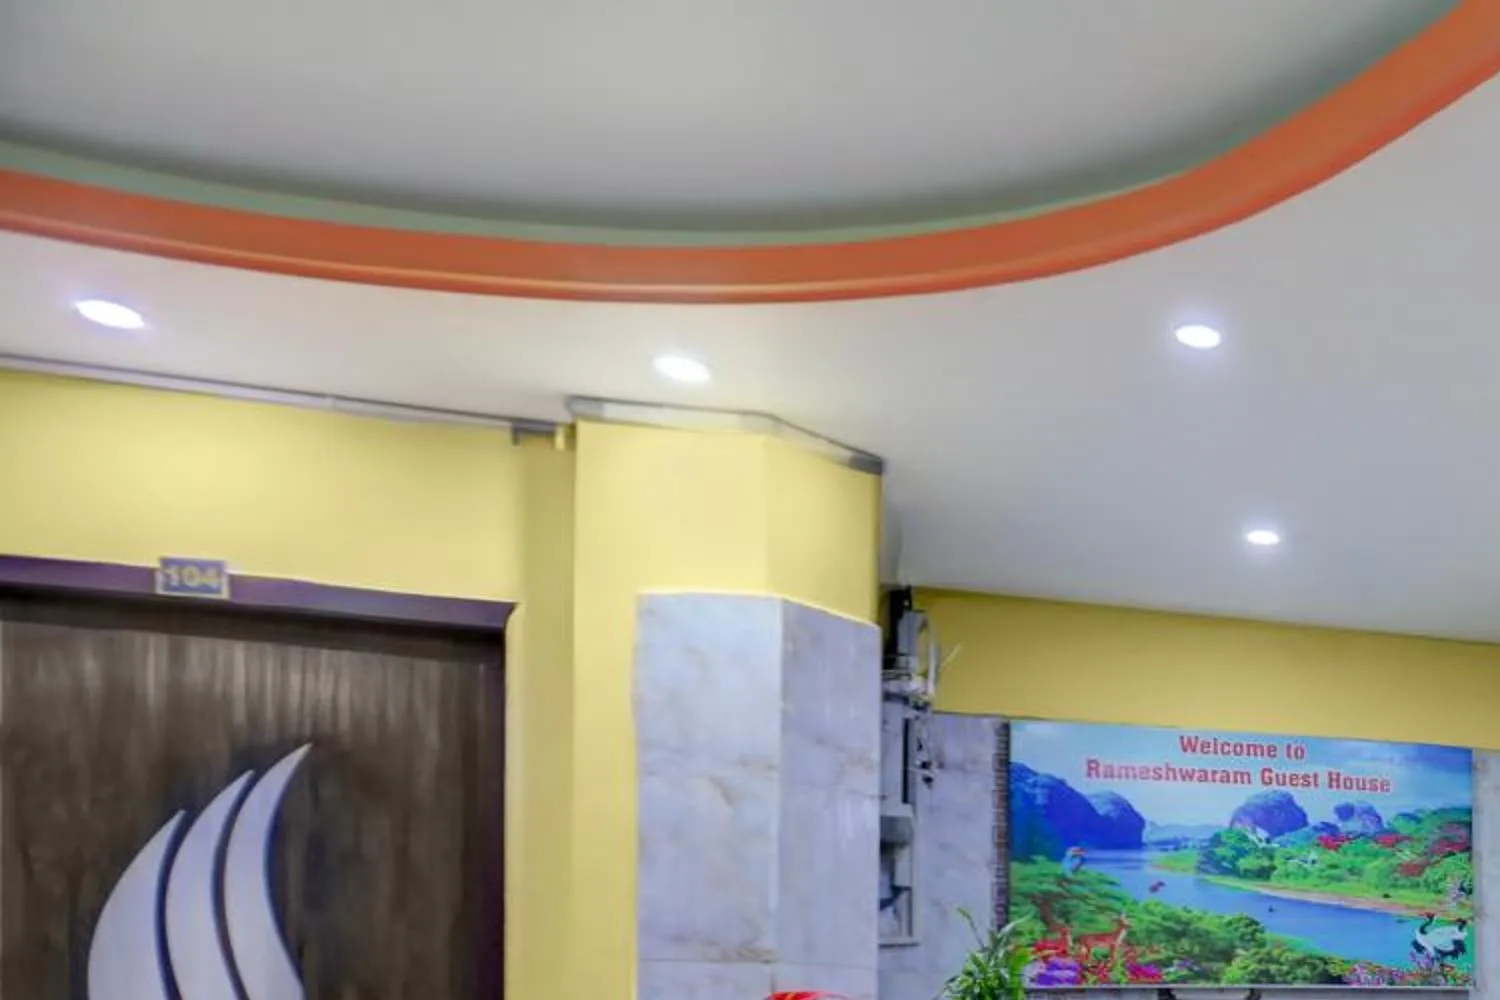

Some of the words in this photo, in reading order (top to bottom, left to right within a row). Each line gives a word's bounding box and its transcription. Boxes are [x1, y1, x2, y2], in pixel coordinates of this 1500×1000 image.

[164, 565, 224, 589] 104
[1179, 735, 1278, 759] Welcome
[1285, 743, 1306, 761] to
[1085, 758, 1253, 786] Rameshwaram
[1260, 767, 1320, 789] Guest
[1327, 771, 1392, 793] House
